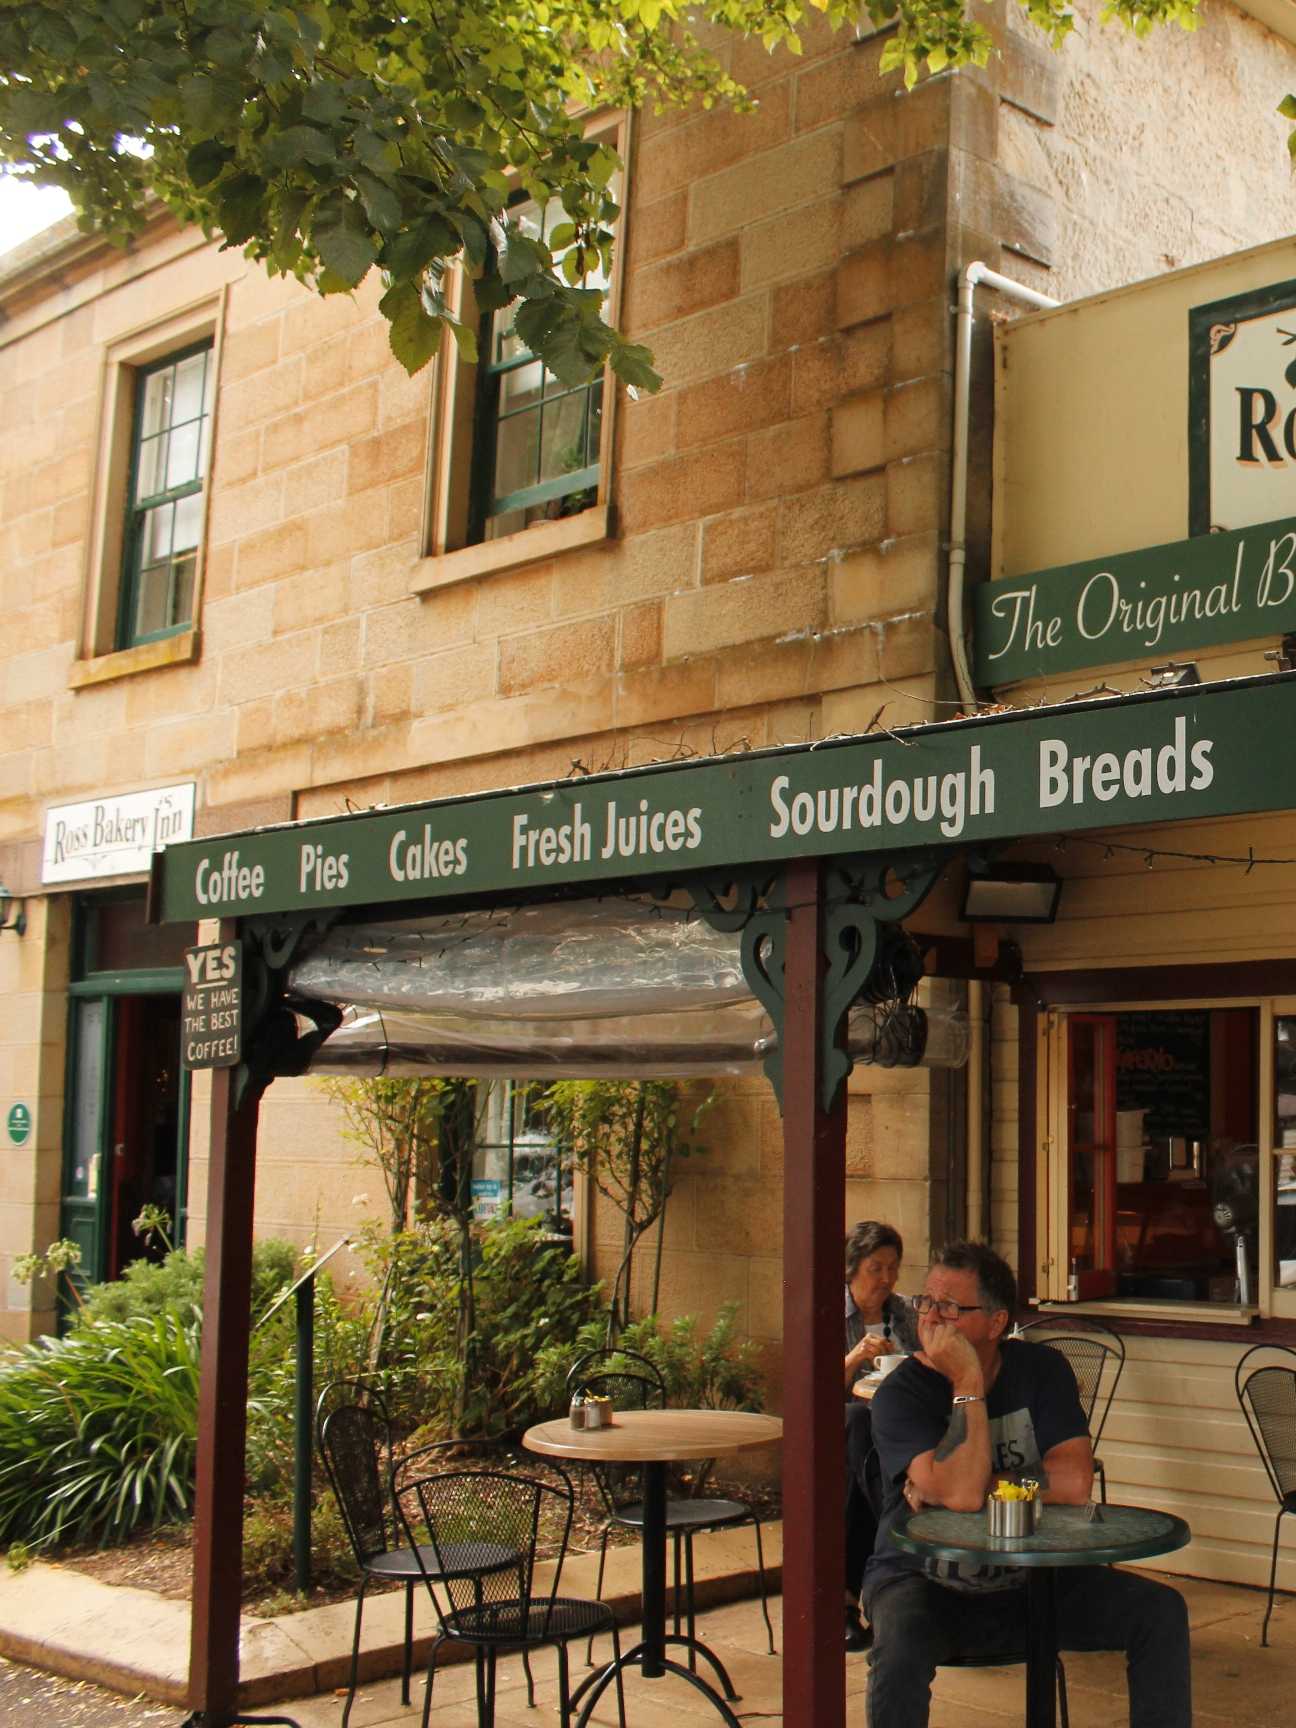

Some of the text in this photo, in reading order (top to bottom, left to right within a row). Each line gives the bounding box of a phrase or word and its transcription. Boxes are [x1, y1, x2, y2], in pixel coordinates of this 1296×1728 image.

[988, 584, 1064, 660] The
[1076, 541, 1246, 647] Original
[195, 850, 265, 905] Coffee
[299, 843, 350, 894] Pies
[388, 823, 469, 882] Cakes
[511, 802, 592, 870] Fresh
[601, 798, 704, 859] Juices
[768, 743, 996, 839] Sourdough
[1038, 714, 1215, 809] Breads
[53, 804, 183, 865] Ross Bakery Inn
[185, 945, 237, 984] YES
[186, 987, 240, 1011] WE HAVE
[184, 1009, 240, 1033] THE BEST
[187, 1034, 238, 1062] COFFEE!
